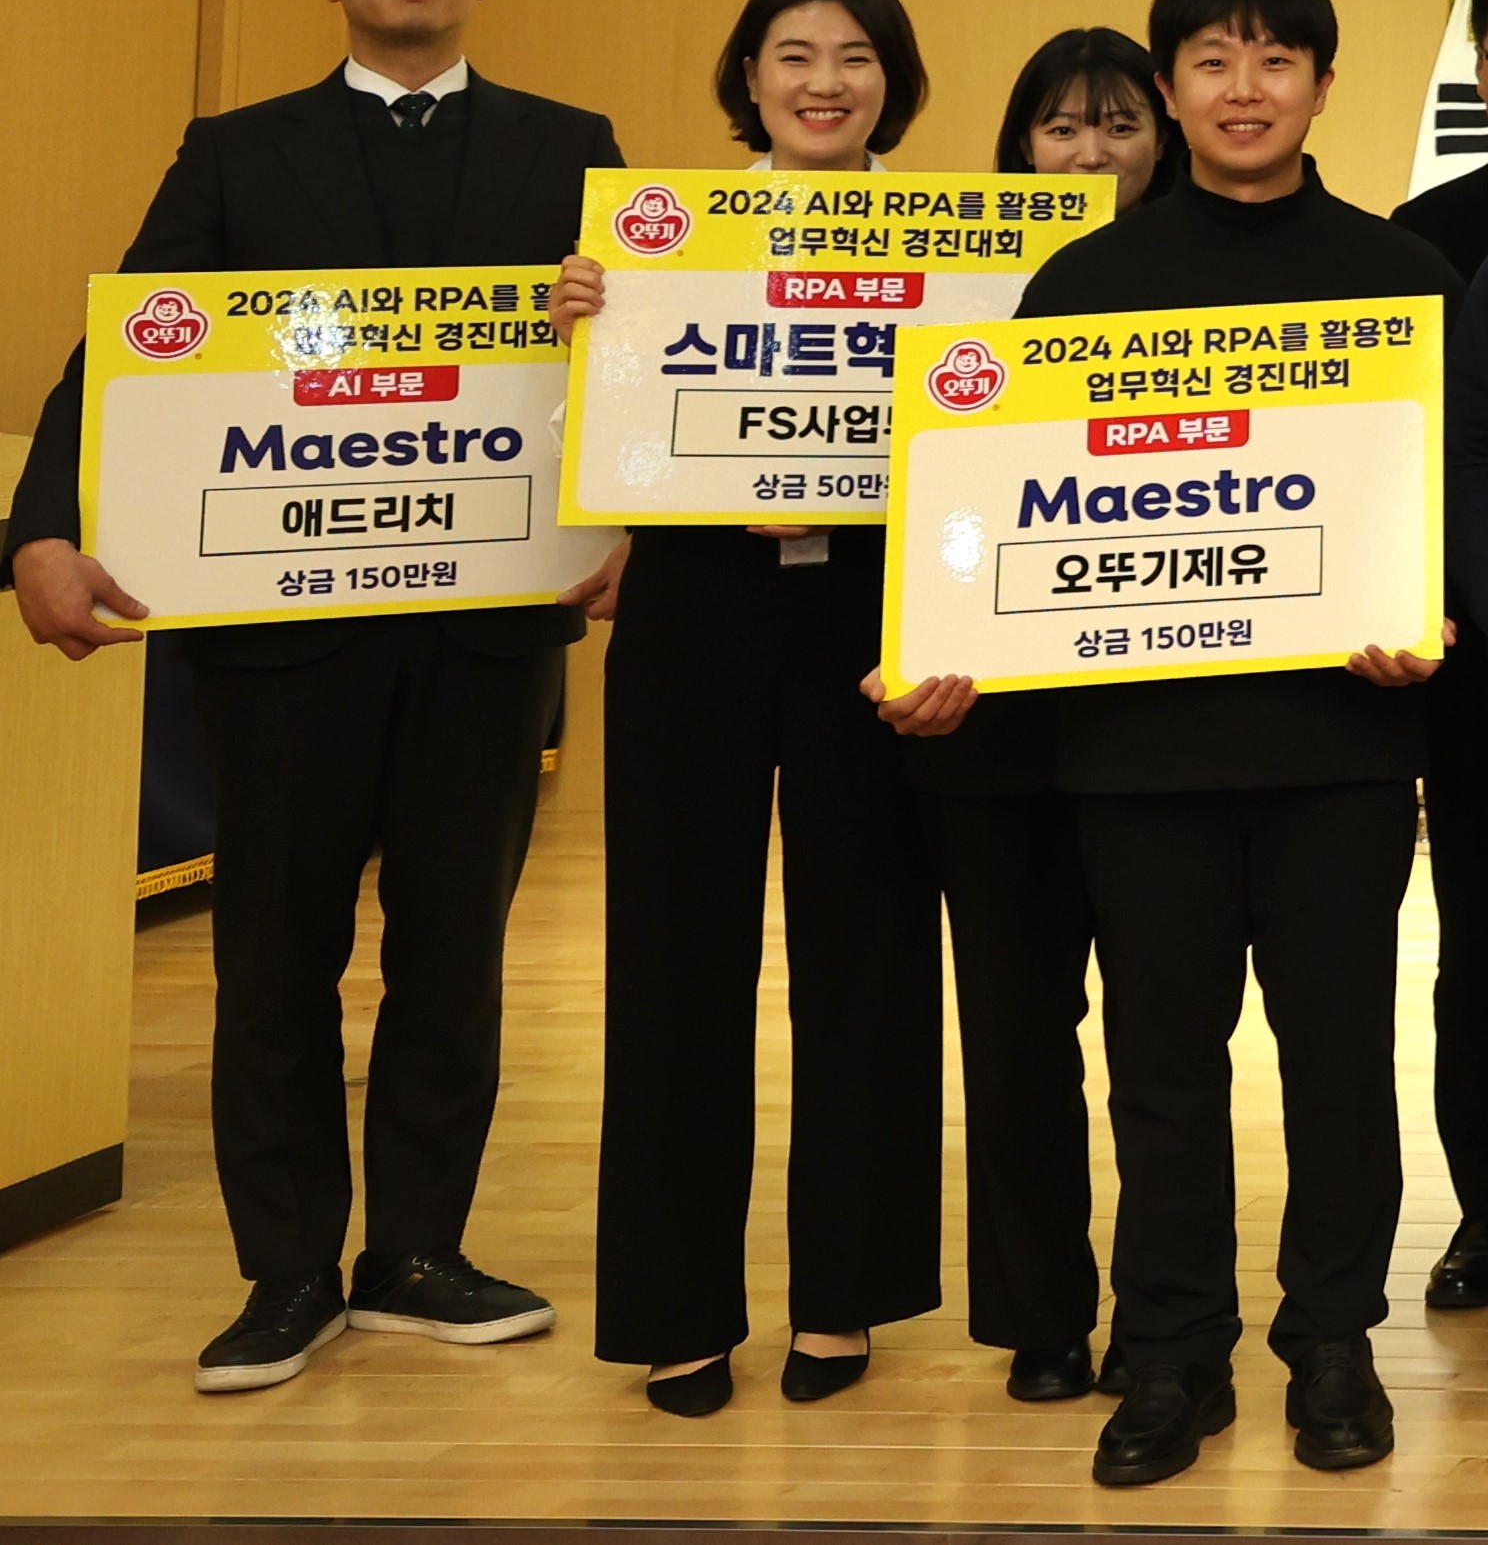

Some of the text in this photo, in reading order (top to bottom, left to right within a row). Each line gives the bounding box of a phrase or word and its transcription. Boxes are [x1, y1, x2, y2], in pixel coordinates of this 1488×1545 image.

[708, 190, 1087, 221] 2024 AI와 RPA를 활용한
[628, 222, 676, 243] 오뚜기
[770, 227, 1022, 258] 업무혁신 경진대회
[227, 290, 317, 316] 2024
[334, 287, 403, 314] AI와
[415, 285, 519, 312] RPA를
[785, 278, 905, 302] RPA 부문
[143, 327, 191, 343] 오뚜기
[435, 321, 558, 351] 경진대회
[661, 322, 894, 378] 스마트혁
[1023, 317, 1413, 364] 2024 AI와 RPA를 활용한
[328, 373, 424, 397] AI 부문
[943, 377, 991, 398] 오뚜기
[1087, 359, 1348, 402] 업무혁신 경진대회
[739, 406, 892, 443] FS사업
[1107, 417, 1230, 446] RPA 부문
[220, 422, 522, 473] Maestro
[753, 474, 889, 500] 상금 50만
[1018, 470, 1315, 528] Maestro
[283, 493, 453, 537] 애드리치
[277, 561, 456, 596] 상금 150만원
[1052, 544, 1267, 594] 오뚜기제유
[1074, 619, 1251, 658] 상금 150만원
